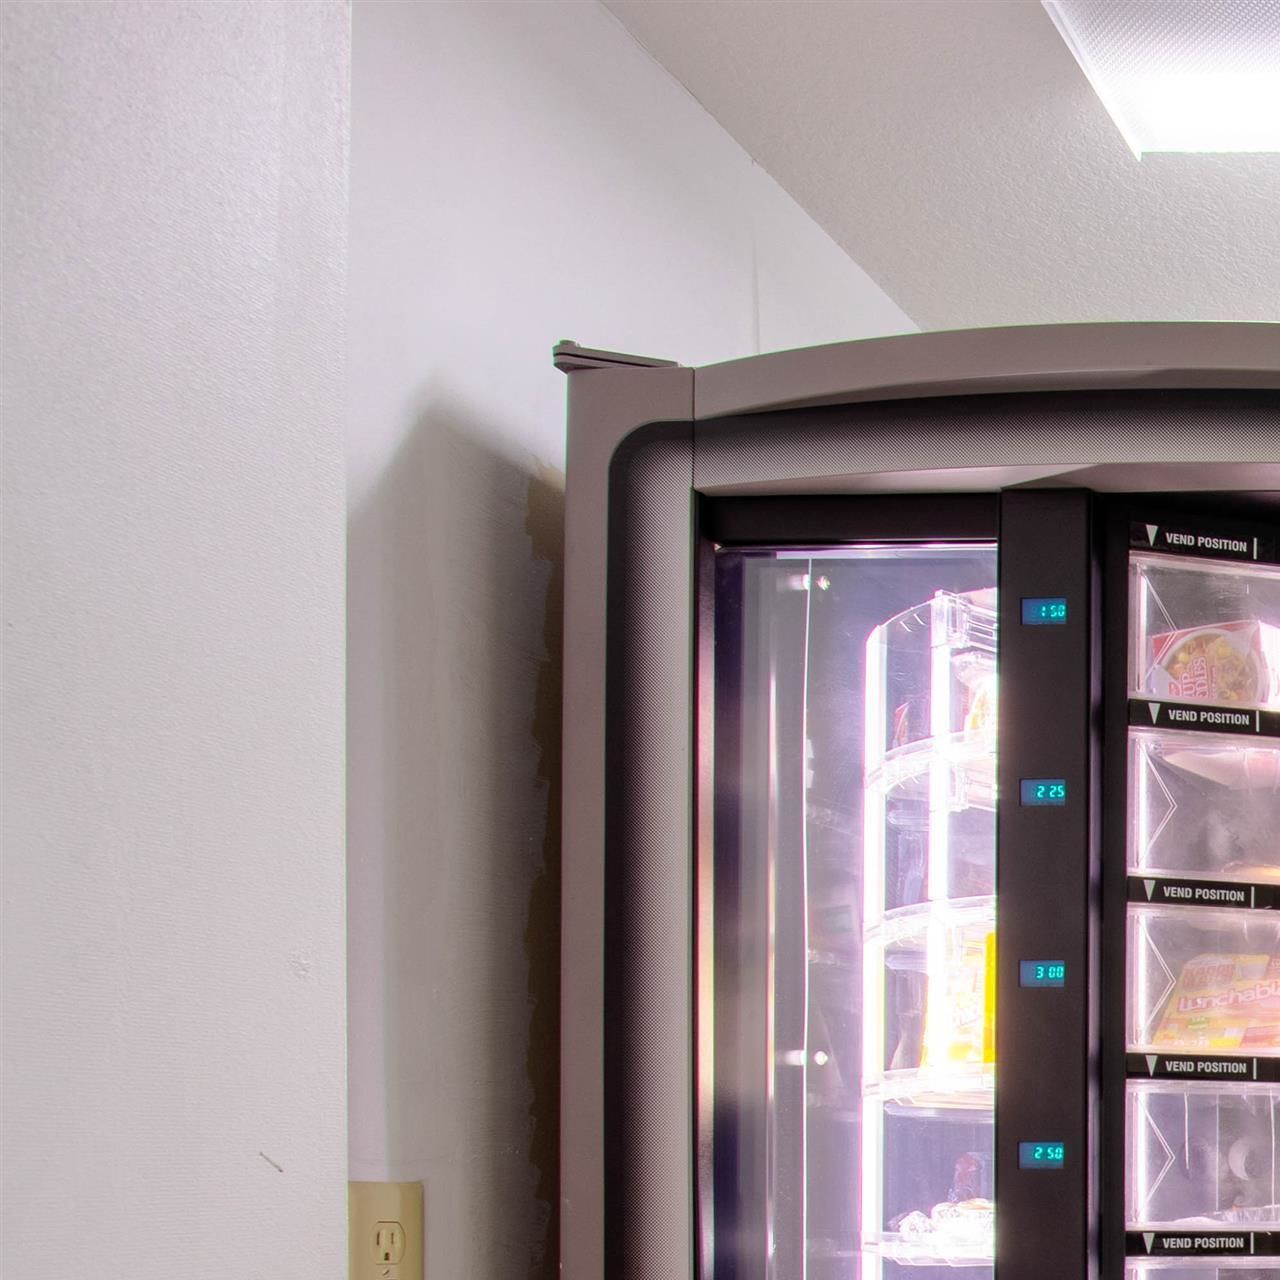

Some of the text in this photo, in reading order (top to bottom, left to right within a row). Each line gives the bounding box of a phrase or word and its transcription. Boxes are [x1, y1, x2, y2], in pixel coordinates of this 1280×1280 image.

[1165, 532, 1247, 552] VEND POSITION
[1168, 709, 1250, 725] VEND POSITION
[1163, 886, 1245, 902] VEND POSITION
[1165, 1060, 1247, 1074] VEND POSITION
[1162, 1237, 1244, 1249] VEND POSITION
